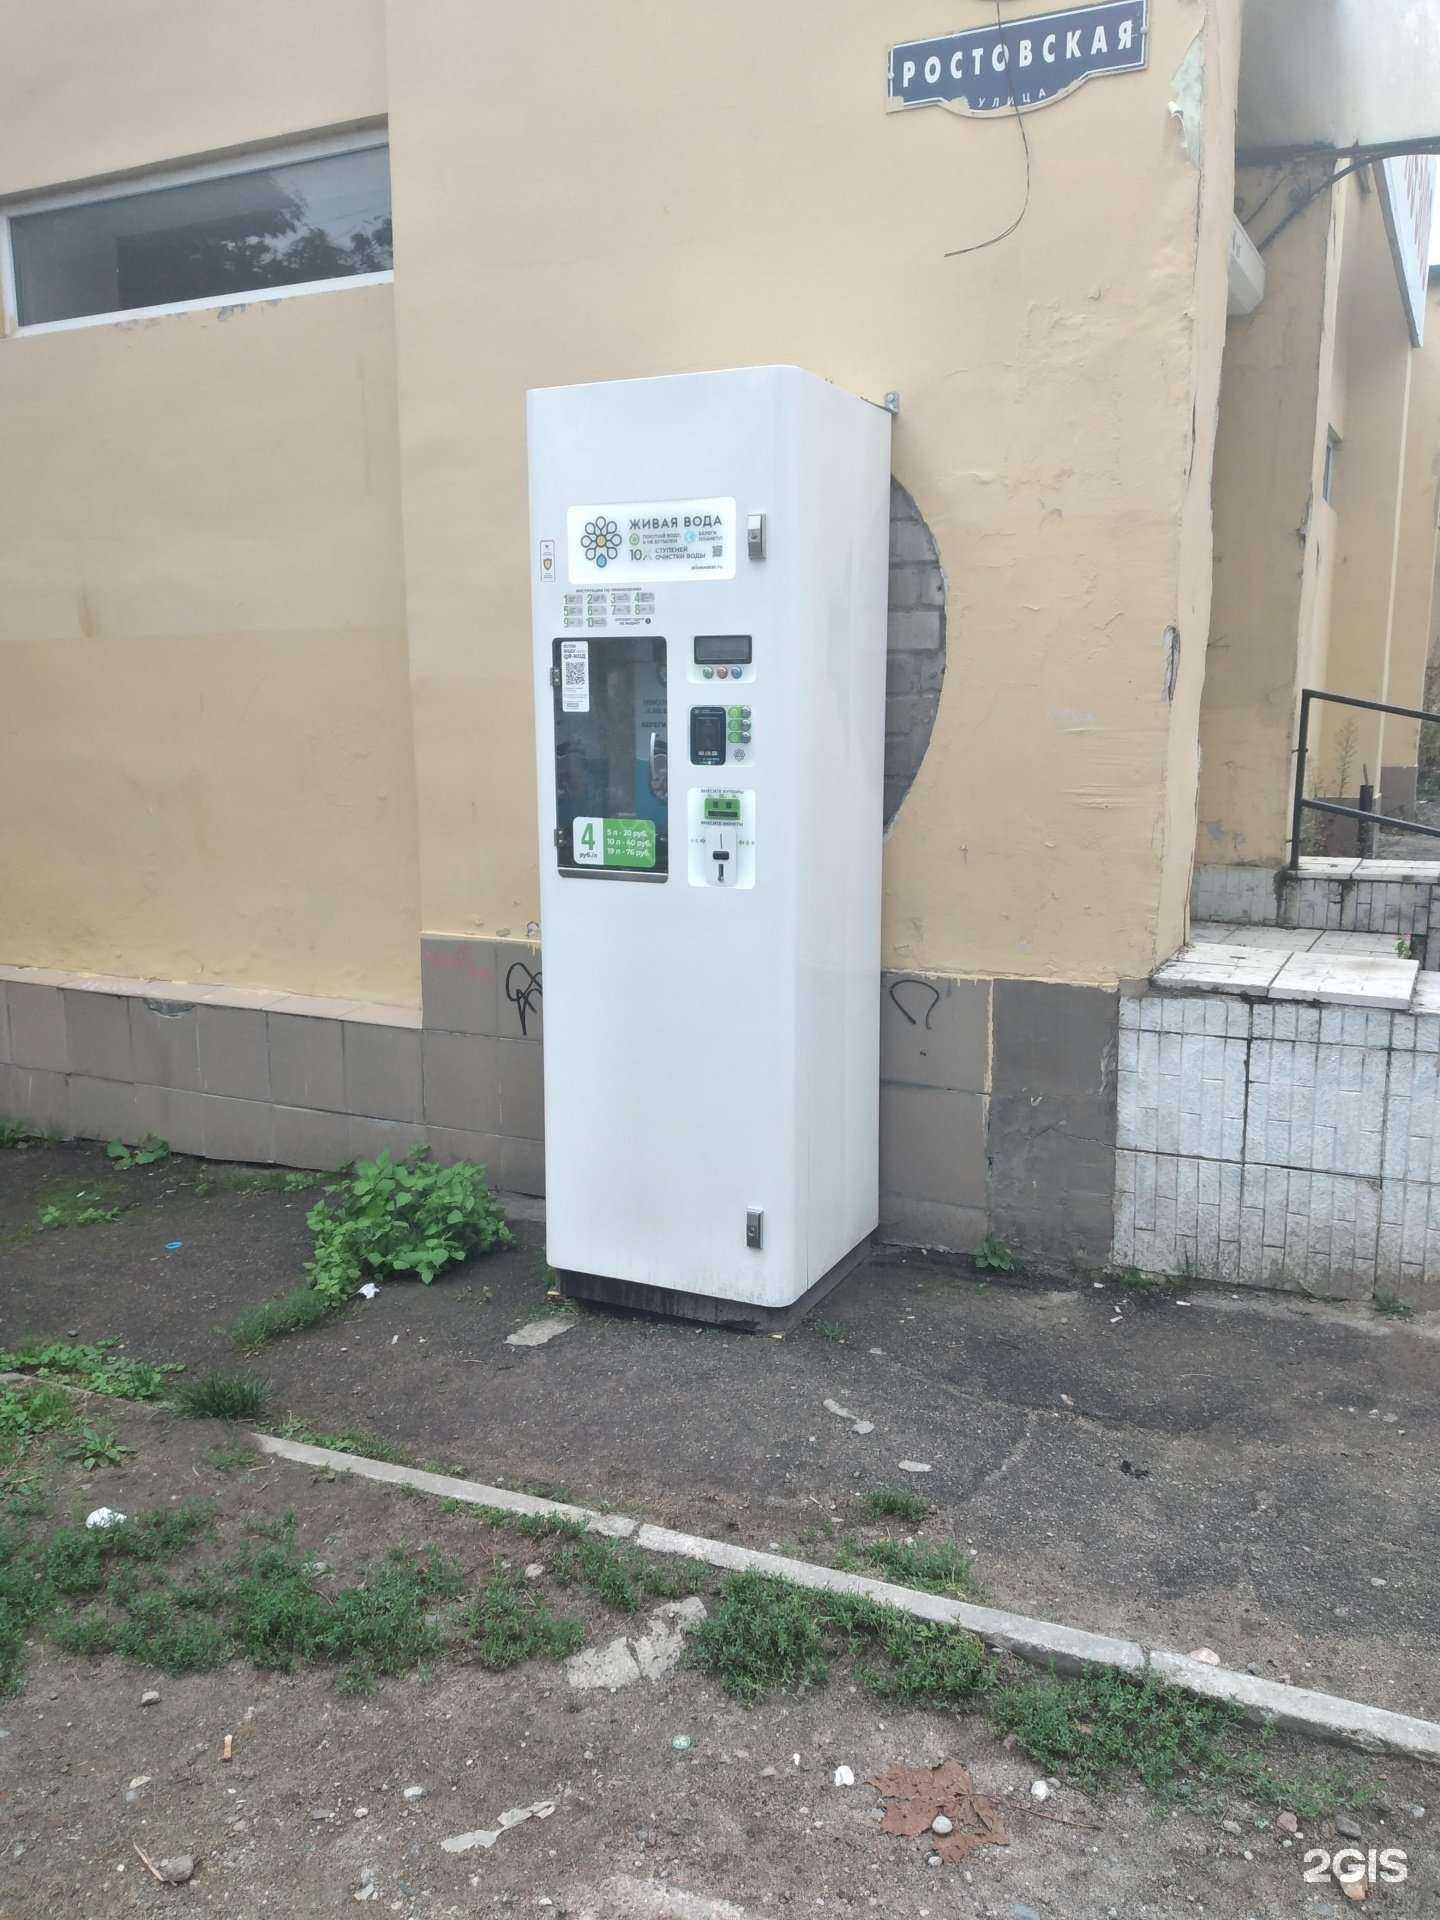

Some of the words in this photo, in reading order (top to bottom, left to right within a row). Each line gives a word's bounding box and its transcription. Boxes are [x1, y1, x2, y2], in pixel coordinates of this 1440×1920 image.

[902, 20, 1132, 88] РОСТОВСКАЯ
[977, 88, 1046, 108] УЛИЦА
[629, 517, 678, 530] ЖИВАЯ
[684, 515, 722, 528] ВОДА
[655, 545, 688, 553] СТУПЕНЕЙ
[581, 822, 596, 851] 4
